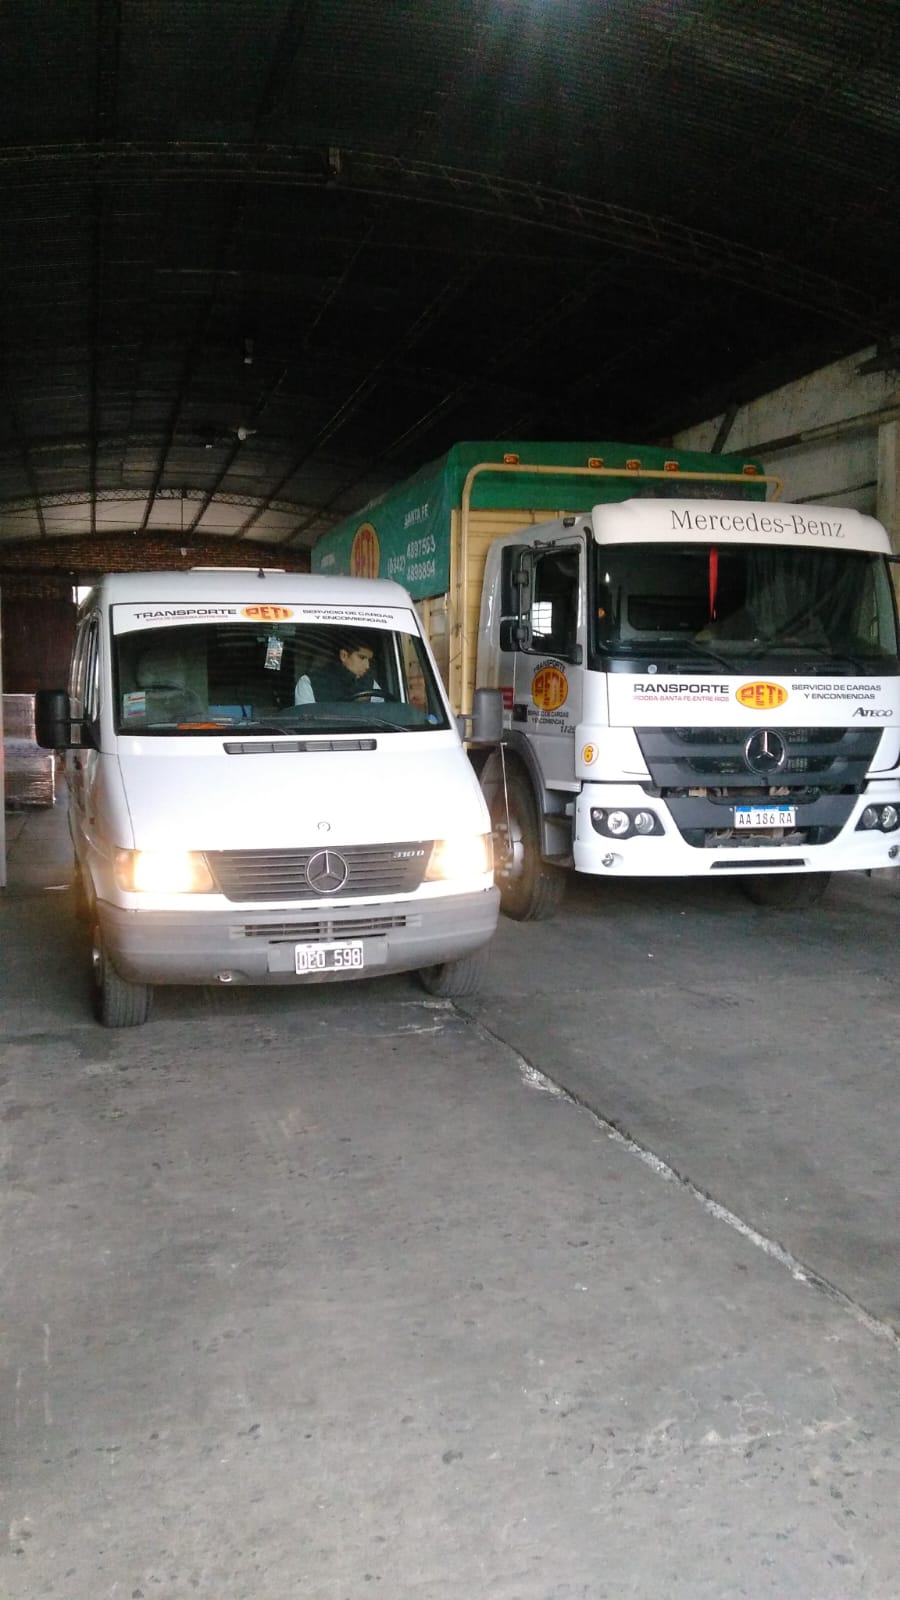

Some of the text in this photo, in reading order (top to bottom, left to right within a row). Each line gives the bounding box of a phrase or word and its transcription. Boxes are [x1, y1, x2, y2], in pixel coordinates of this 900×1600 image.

[670, 509, 846, 538] Mercedes-Benz
[133, 609, 237, 619] TRANSPORTE
[245, 606, 289, 620] PETI
[359, 611, 394, 620] CARGAS
[741, 684, 784, 706] PETI
[584, 745, 594, 763] 6
[739, 812, 792, 824] AA 186 RA
[298, 948, 361, 970] DEO 598
